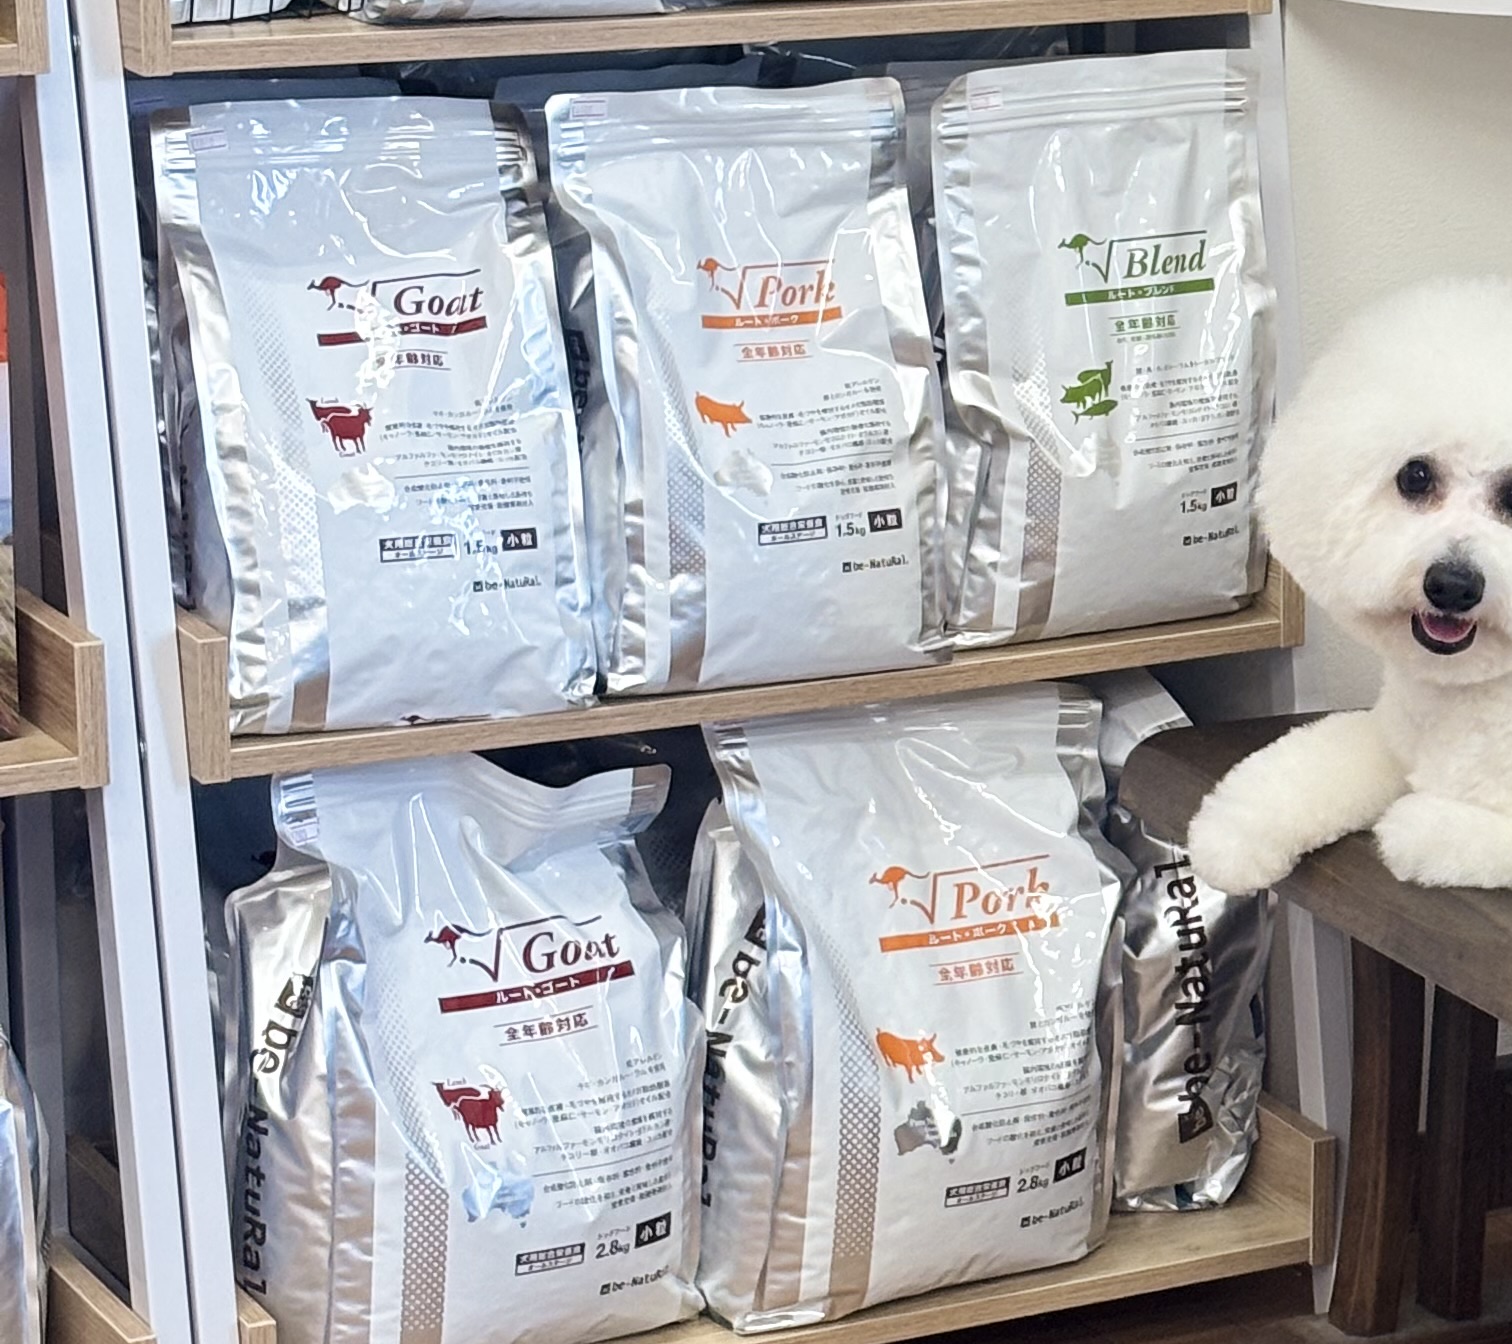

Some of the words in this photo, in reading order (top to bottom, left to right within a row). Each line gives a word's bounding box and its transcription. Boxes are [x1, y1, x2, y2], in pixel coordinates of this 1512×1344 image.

[1121, 239, 1207, 280] Blend
[393, 285, 484, 317] Goat
[753, 269, 836, 308] Pork
[835, 523, 867, 538] 1.5kg
[951, 866, 1051, 921] Pork
[522, 931, 620, 974] Goat
[496, 976, 582, 1004] ルート・ゴート
[504, 1011, 589, 1041] 全年齢対応
[1016, 1174, 1049, 1194] 2.8kg
[595, 1239, 631, 1259] 2.8kg
